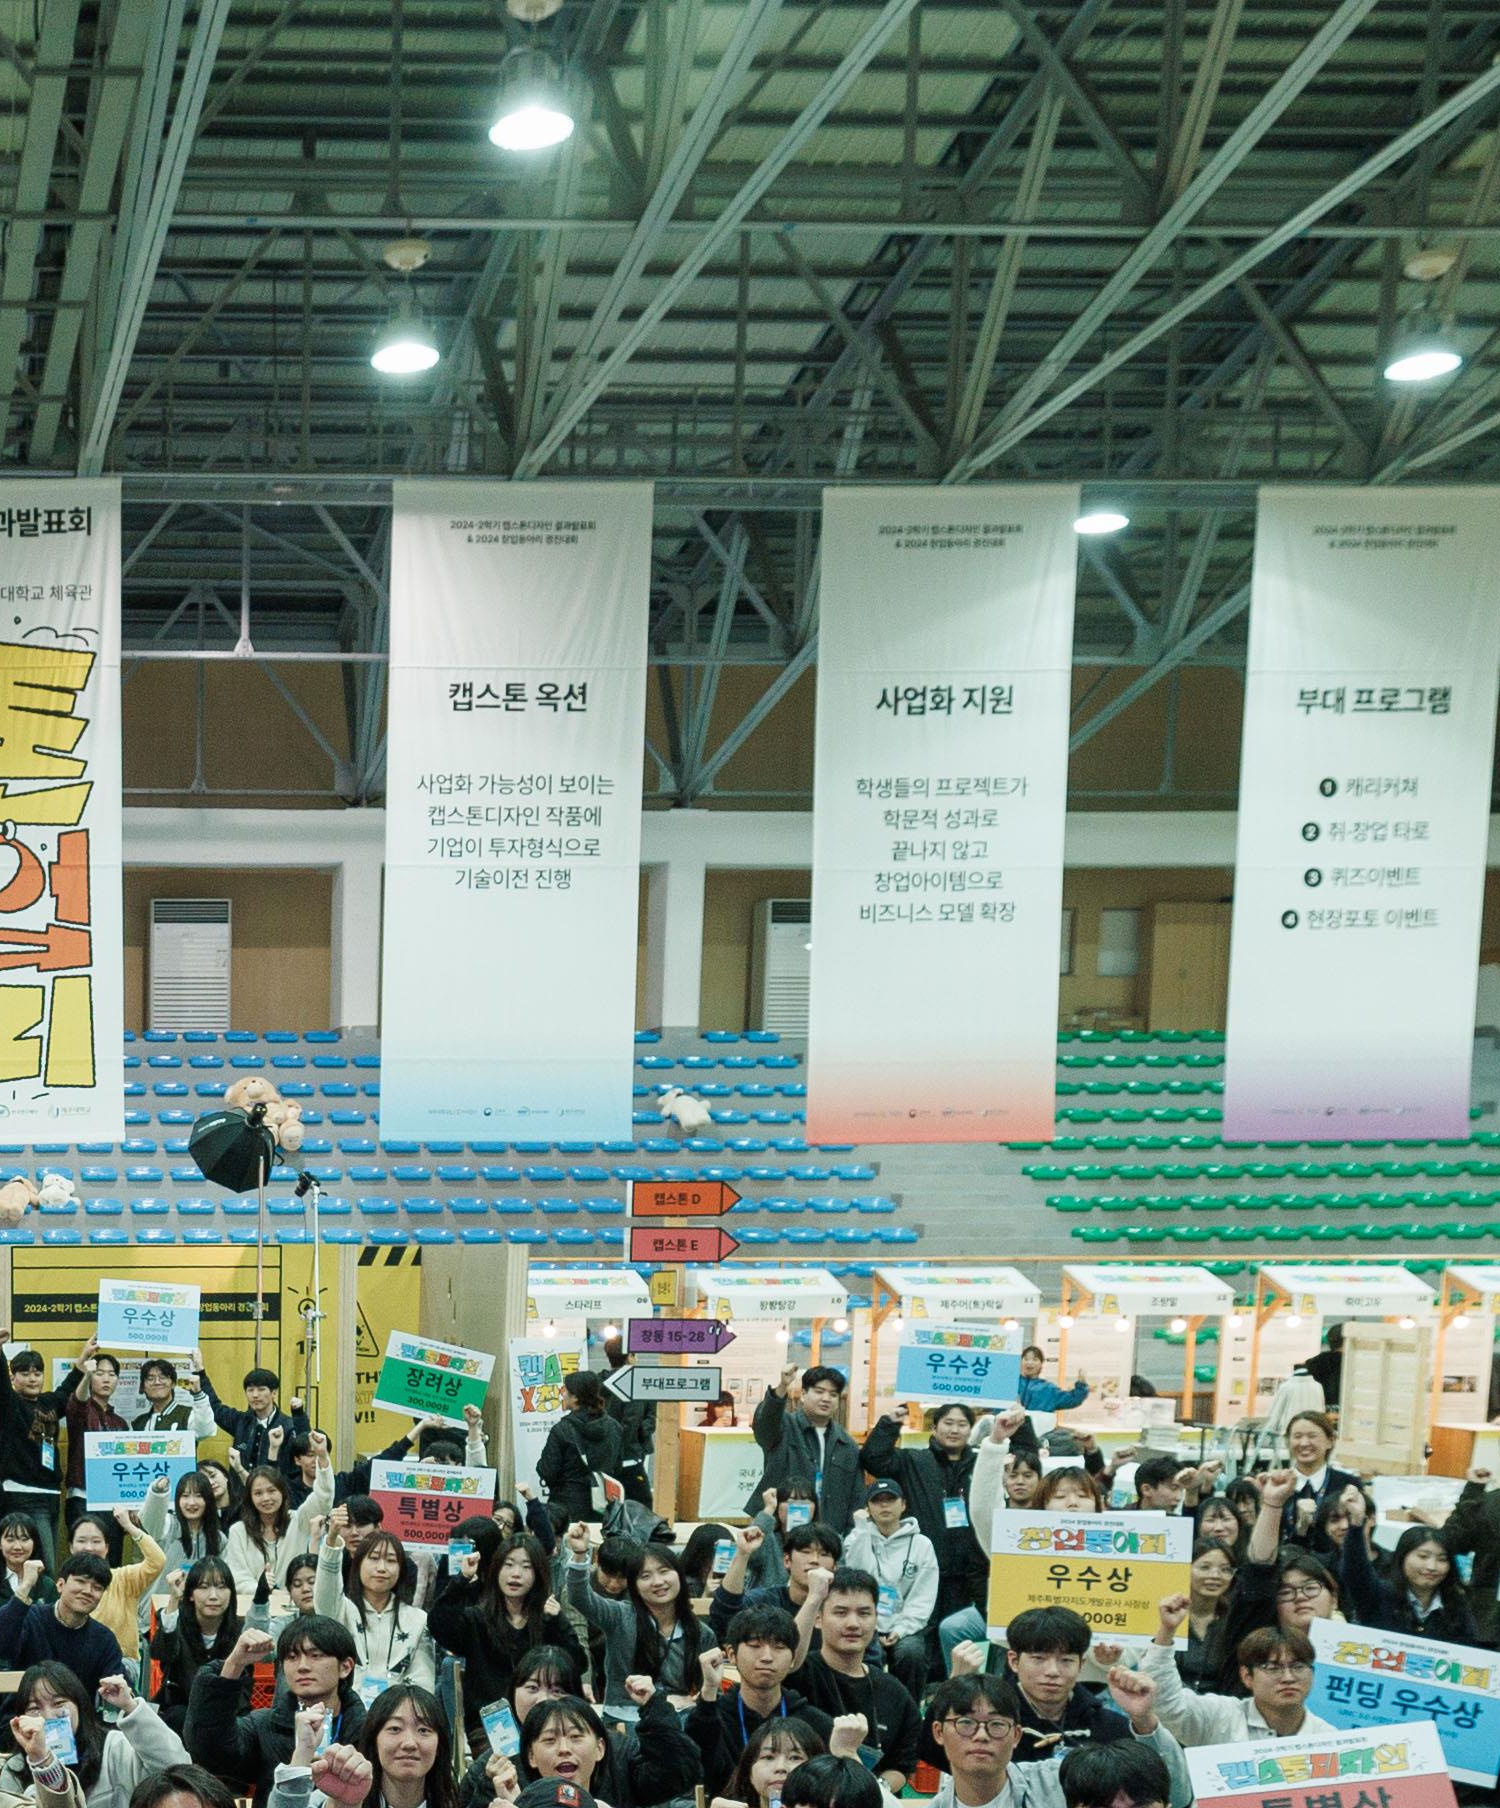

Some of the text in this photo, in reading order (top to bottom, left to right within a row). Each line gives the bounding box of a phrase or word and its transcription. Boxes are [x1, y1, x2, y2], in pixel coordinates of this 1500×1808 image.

[49, 583, 93, 602] 체육관
[447, 681, 588, 713] 캡스톤 옥션
[875, 686, 1014, 715] 사업화 지원
[1296, 686, 1452, 715] 부대 프로그램
[416, 772, 616, 795] 사업화 가능성이 보이는
[855, 776, 1028, 799] 학생들의 프로젝트가
[427, 804, 602, 828] 캡스톤디자인 작품에
[883, 808, 999, 830] 학문적 성과로
[427, 836, 601, 859] 기업이 투자형식으로
[890, 840, 989, 861] 끝나지 않고
[454, 867, 572, 890] 기술이전 진행
[874, 871, 1004, 893] 창업아이템으로
[858, 902, 1017, 924] 비즈니스 모델 확장
[653, 1192, 701, 1207] 캡스톤 D
[652, 1239, 699, 1252] 캡스톤 E
[121, 1306, 176, 1327] 우수상
[667, 1331, 705, 1343] 15-28
[926, 1352, 992, 1377] 우수상
[406, 1367, 463, 1397] 장려상
[640, 1378, 711, 1391] 부대프로그램
[932, 1381, 981, 1395] 500,000원
[397, 1496, 464, 1522] 특별상
[1046, 1563, 1134, 1593] 우수상
[1325, 1674, 1484, 1731] 펀딩 우수상
